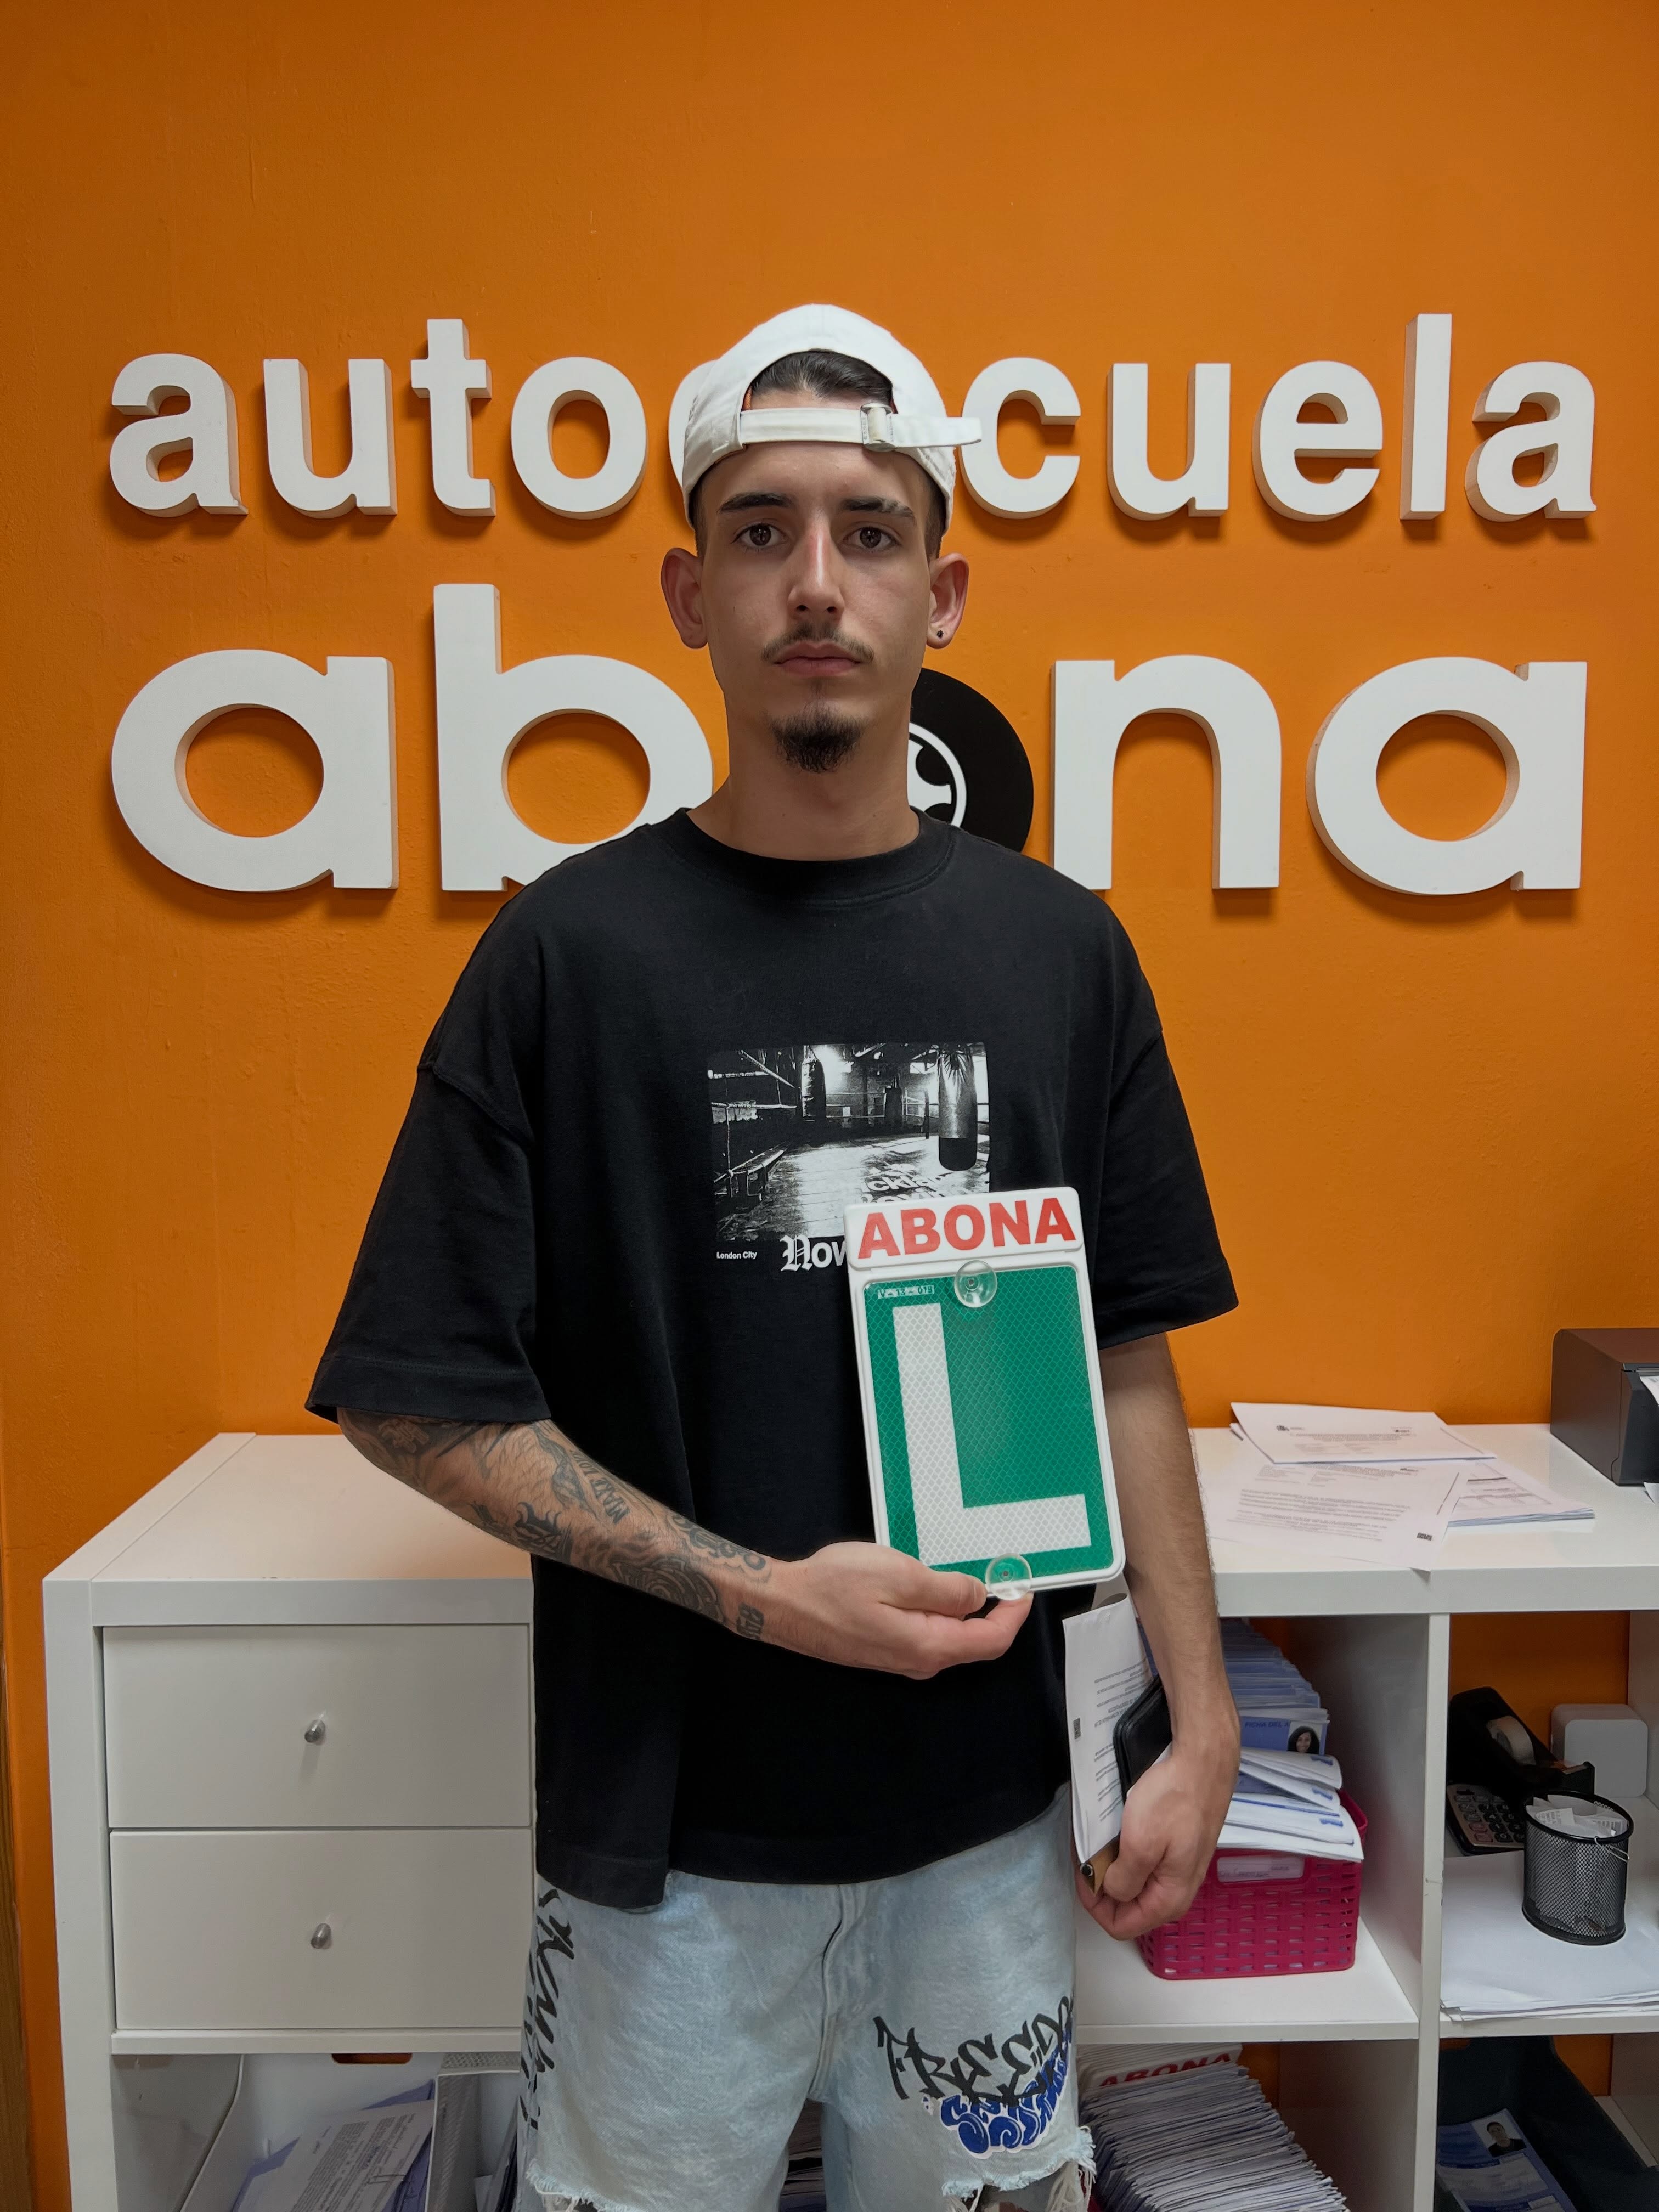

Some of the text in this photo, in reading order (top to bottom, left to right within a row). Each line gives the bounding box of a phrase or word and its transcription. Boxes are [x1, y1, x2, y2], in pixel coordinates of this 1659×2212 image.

[110, 313, 1597, 522] autocuela
[742, 1251, 758, 1260] City
[857, 1198, 1076, 1259] ABONA
[893, 1302, 1092, 1566] L
[589, 1477, 630, 1524] MAKE
